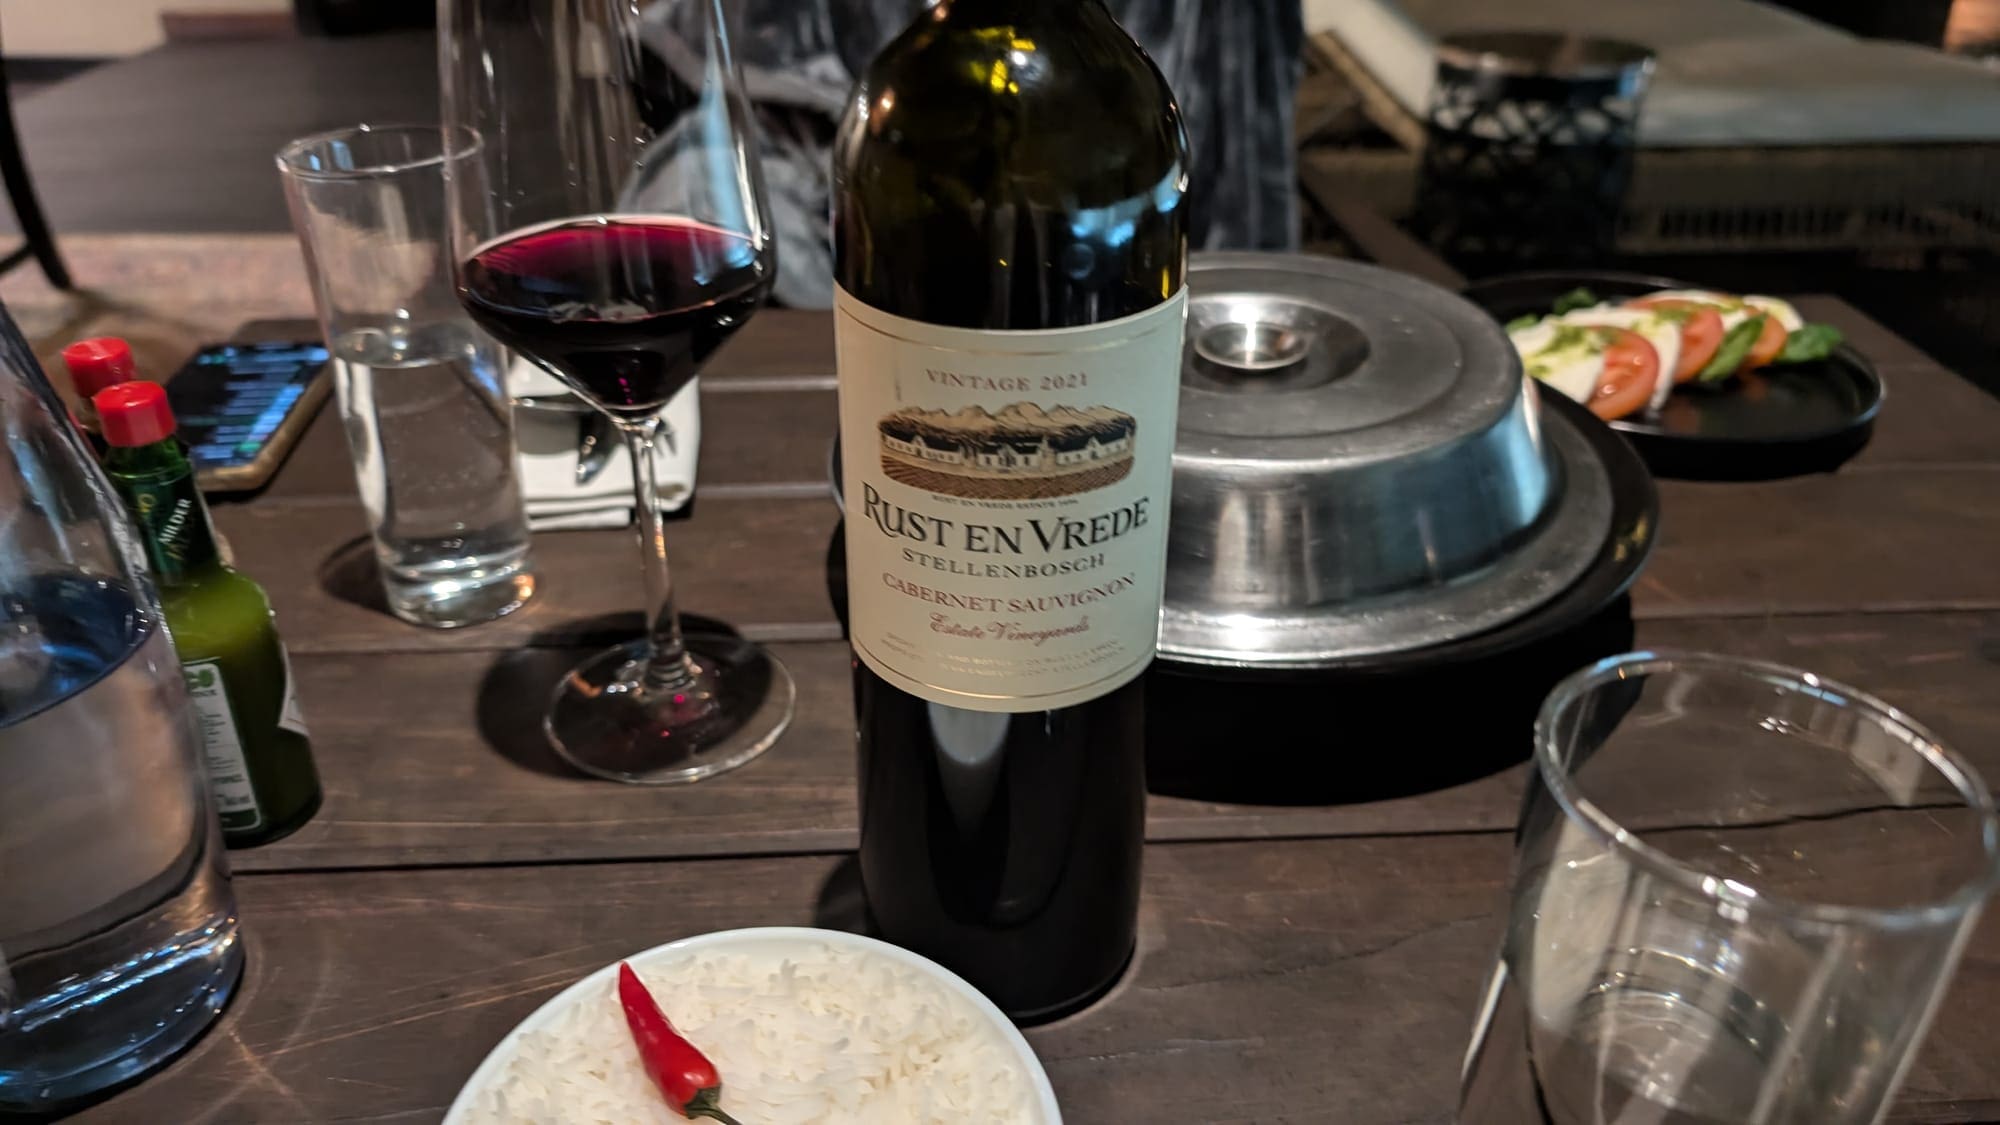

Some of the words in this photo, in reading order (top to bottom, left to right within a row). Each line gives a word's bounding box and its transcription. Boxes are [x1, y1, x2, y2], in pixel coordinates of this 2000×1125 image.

[926, 368, 1030, 391] VINTAGE
[1040, 371, 1088, 391] 2021
[158, 498, 192, 544] MILDER
[862, 481, 954, 548] RUST
[965, 523, 1022, 554] EN
[1027, 497, 1150, 554] VREDE
[902, 547, 1105, 578] STELLENBOSCH
[882, 572, 1003, 613] CABERNET
[1008, 572, 1136, 613] SAUVIGNON
[929, 611, 986, 638] Estate
[987, 614, 1090, 647] Vineyards
